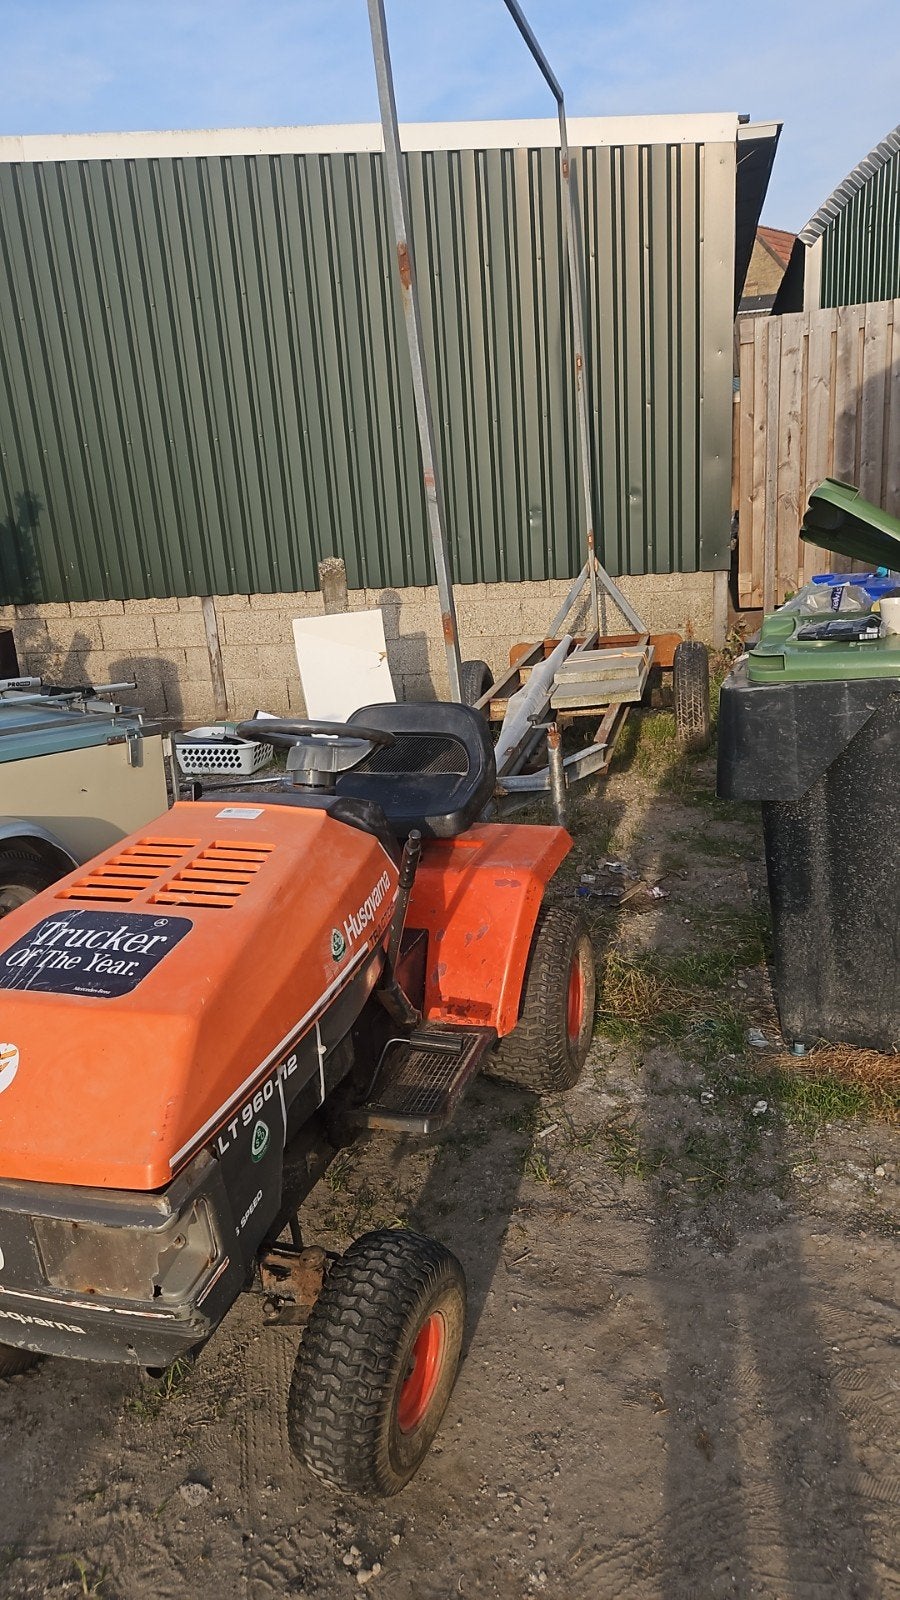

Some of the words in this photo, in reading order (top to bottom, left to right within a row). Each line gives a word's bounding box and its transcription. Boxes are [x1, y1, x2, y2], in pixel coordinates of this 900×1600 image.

[343, 870, 391, 946] Husqvarna
[31, 921, 168, 954] Trucker
[5, 948, 41, 967] Of
[36, 950, 82, 970] The
[82, 953, 140, 976] Year.
[217, 1117, 239, 1155] LT
[240, 1189, 263, 1229] SPEED
